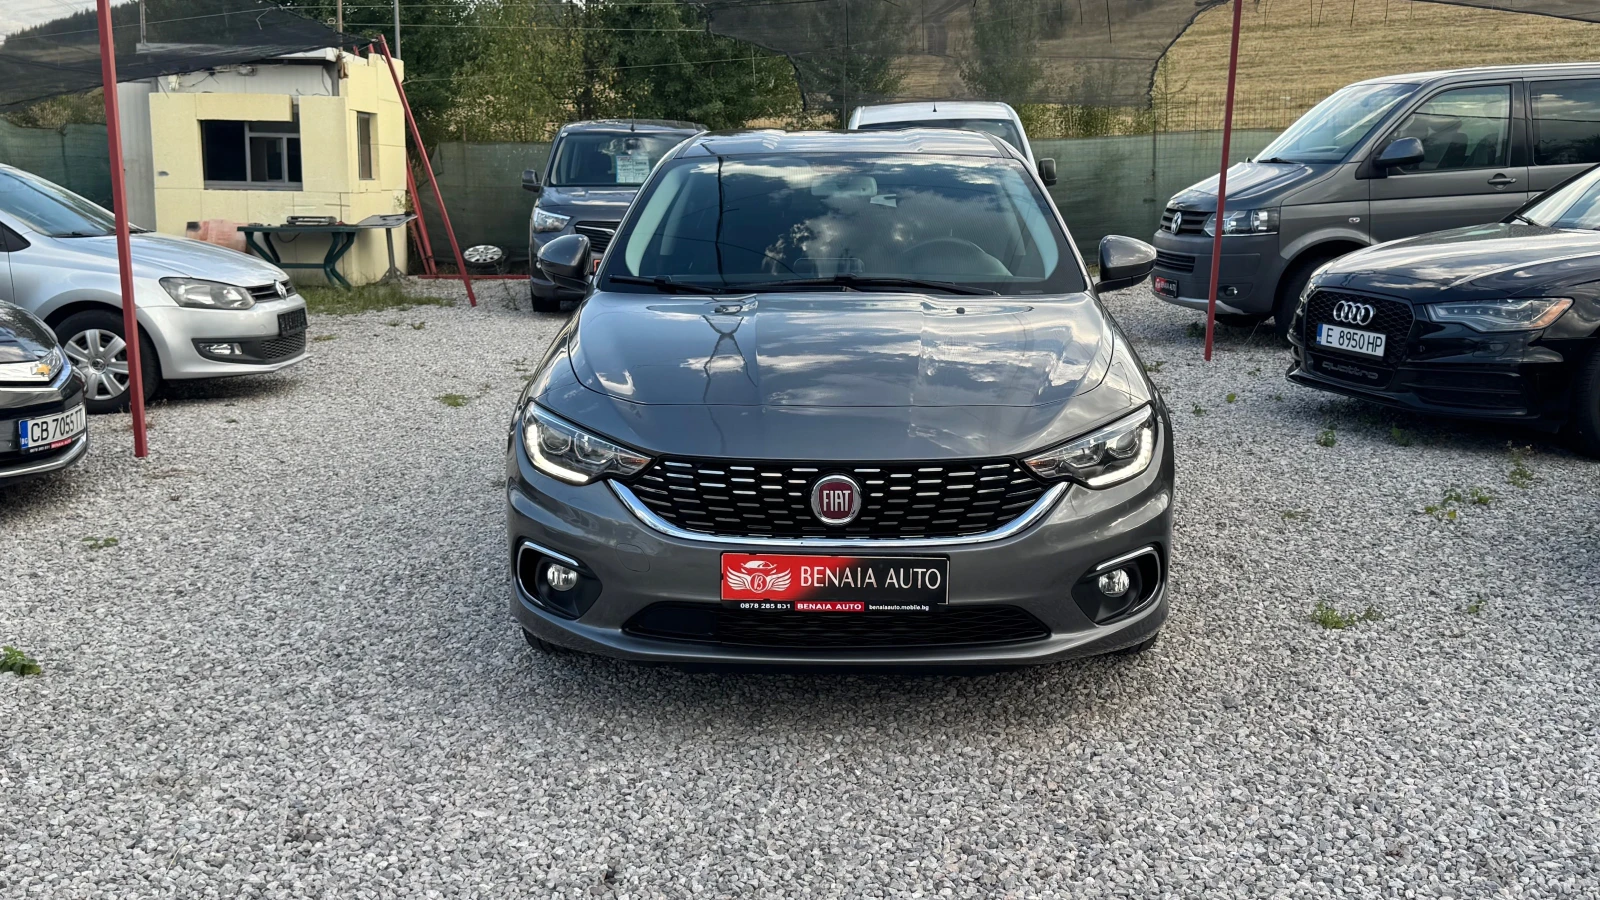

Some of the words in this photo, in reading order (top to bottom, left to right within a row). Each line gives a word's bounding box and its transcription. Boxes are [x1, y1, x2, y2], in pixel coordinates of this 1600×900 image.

[1326, 328, 1333, 344] E
[1338, 330, 1365, 350] 8950
[1366, 334, 1383, 353] HP
[1322, 361, 1378, 379] quattro
[31, 421, 49, 443] CB
[52, 413, 74, 439] 7055
[822, 490, 851, 512] FIAT
[800, 566, 878, 588] BENAIA
[884, 568, 942, 590] AUTO
